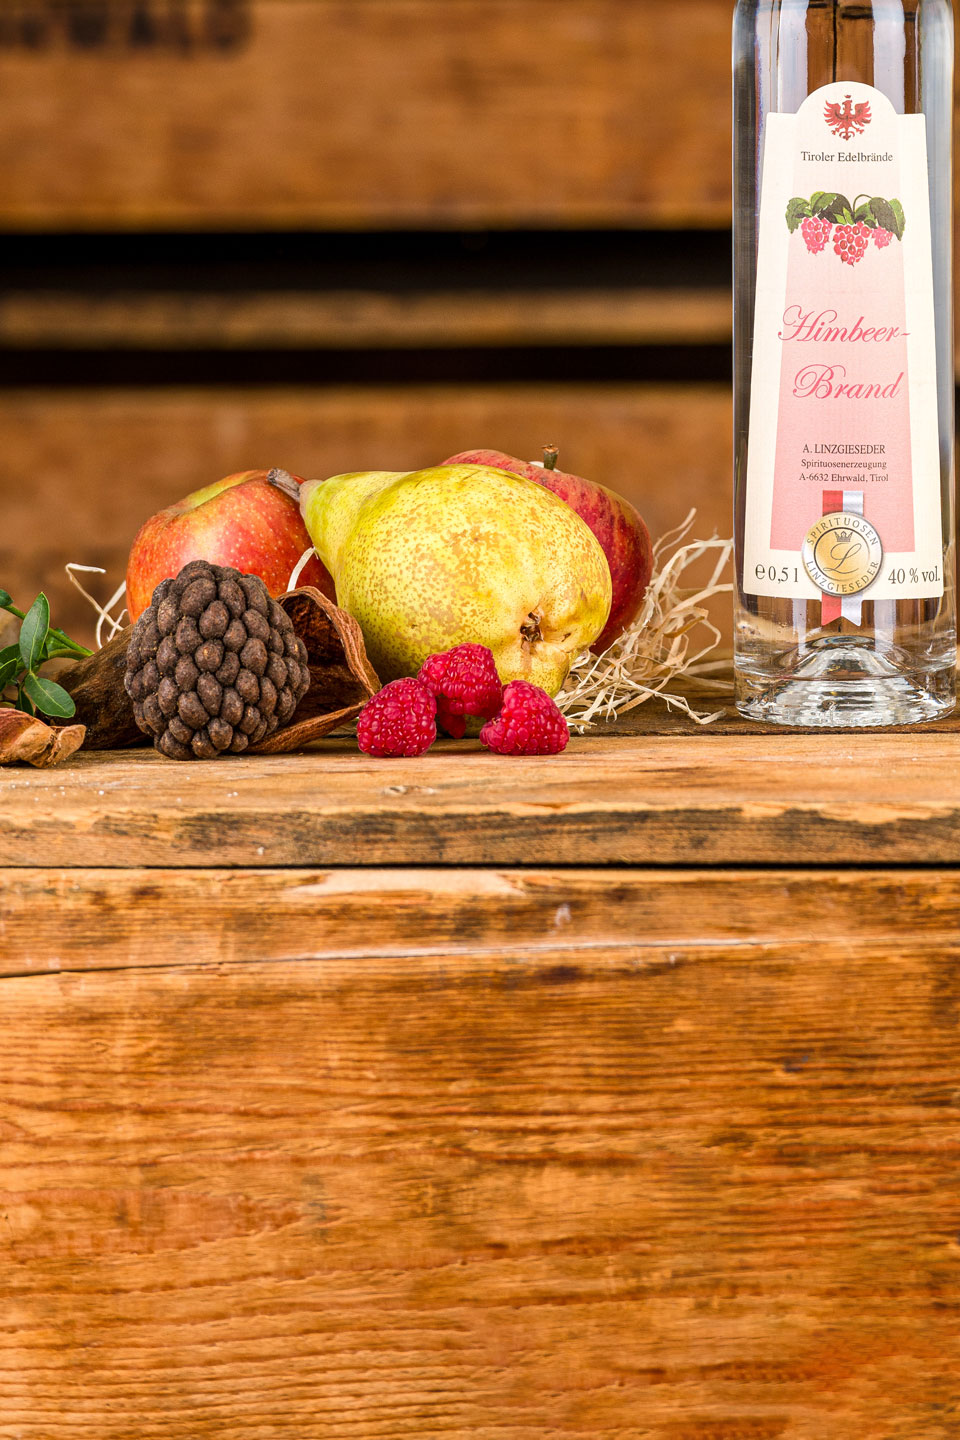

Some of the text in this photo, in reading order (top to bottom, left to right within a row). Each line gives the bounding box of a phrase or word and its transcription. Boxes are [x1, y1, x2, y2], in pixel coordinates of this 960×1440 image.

[800, 150, 893, 163] Tiroler Edelbrände
[777, 304, 911, 343] Himbeer-
[792, 363, 904, 400] Brand
[802, 443, 886, 455] A. LINZGIESEDER
[801, 458, 887, 470] Spirituosenerzeugung
[799, 473, 889, 483] A-6632 Ehrwald, Tirol
[806, 517, 879, 546] SPIRITUOSEN
[768, 565, 789, 584] 0,5
[806, 560, 879, 593] LINZGIESEDER
[887, 565, 941, 584] 40 % vol.
